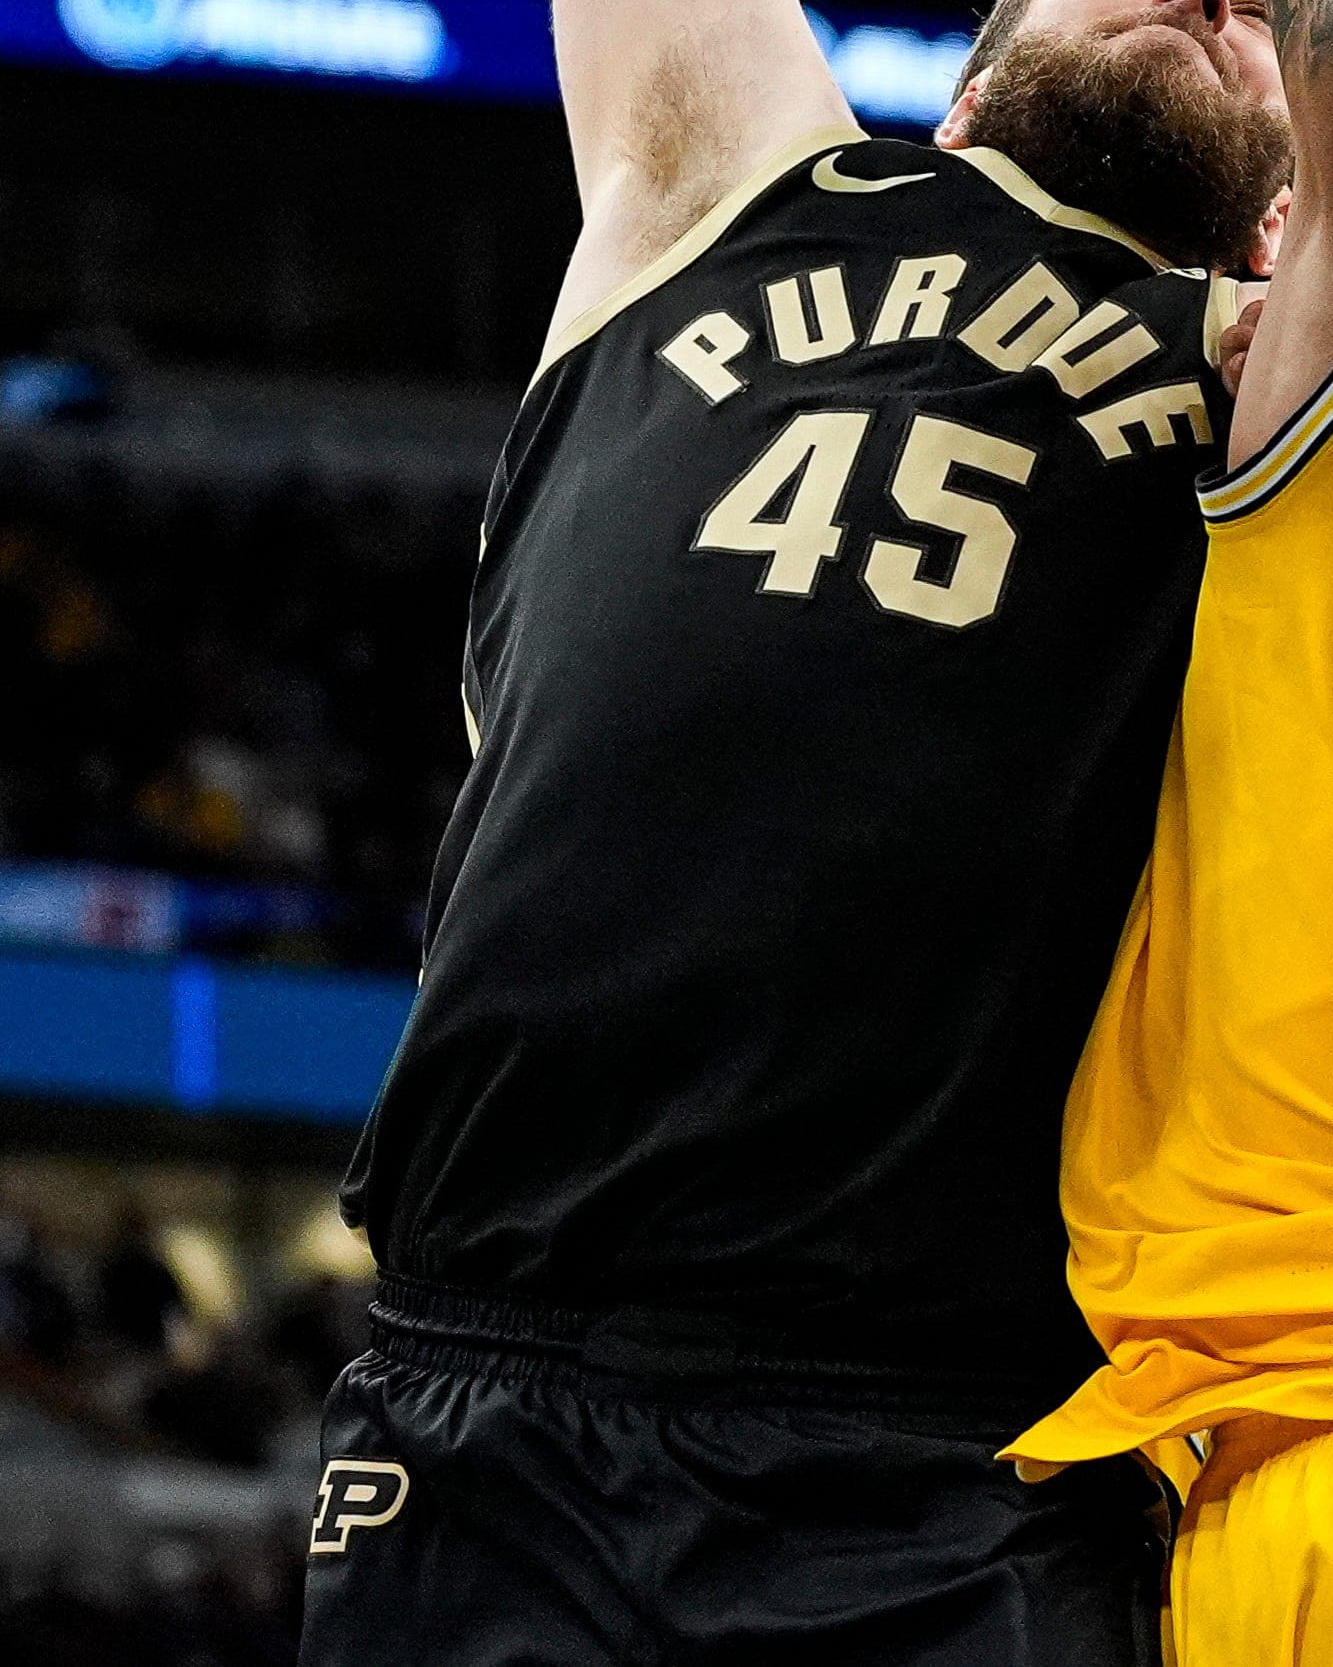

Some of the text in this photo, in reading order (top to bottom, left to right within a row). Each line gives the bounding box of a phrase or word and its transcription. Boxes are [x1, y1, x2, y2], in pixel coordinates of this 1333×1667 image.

[655, 251, 1214, 466] PURDUE
[689, 408, 1043, 630] 45
[309, 1459, 410, 1554] P
